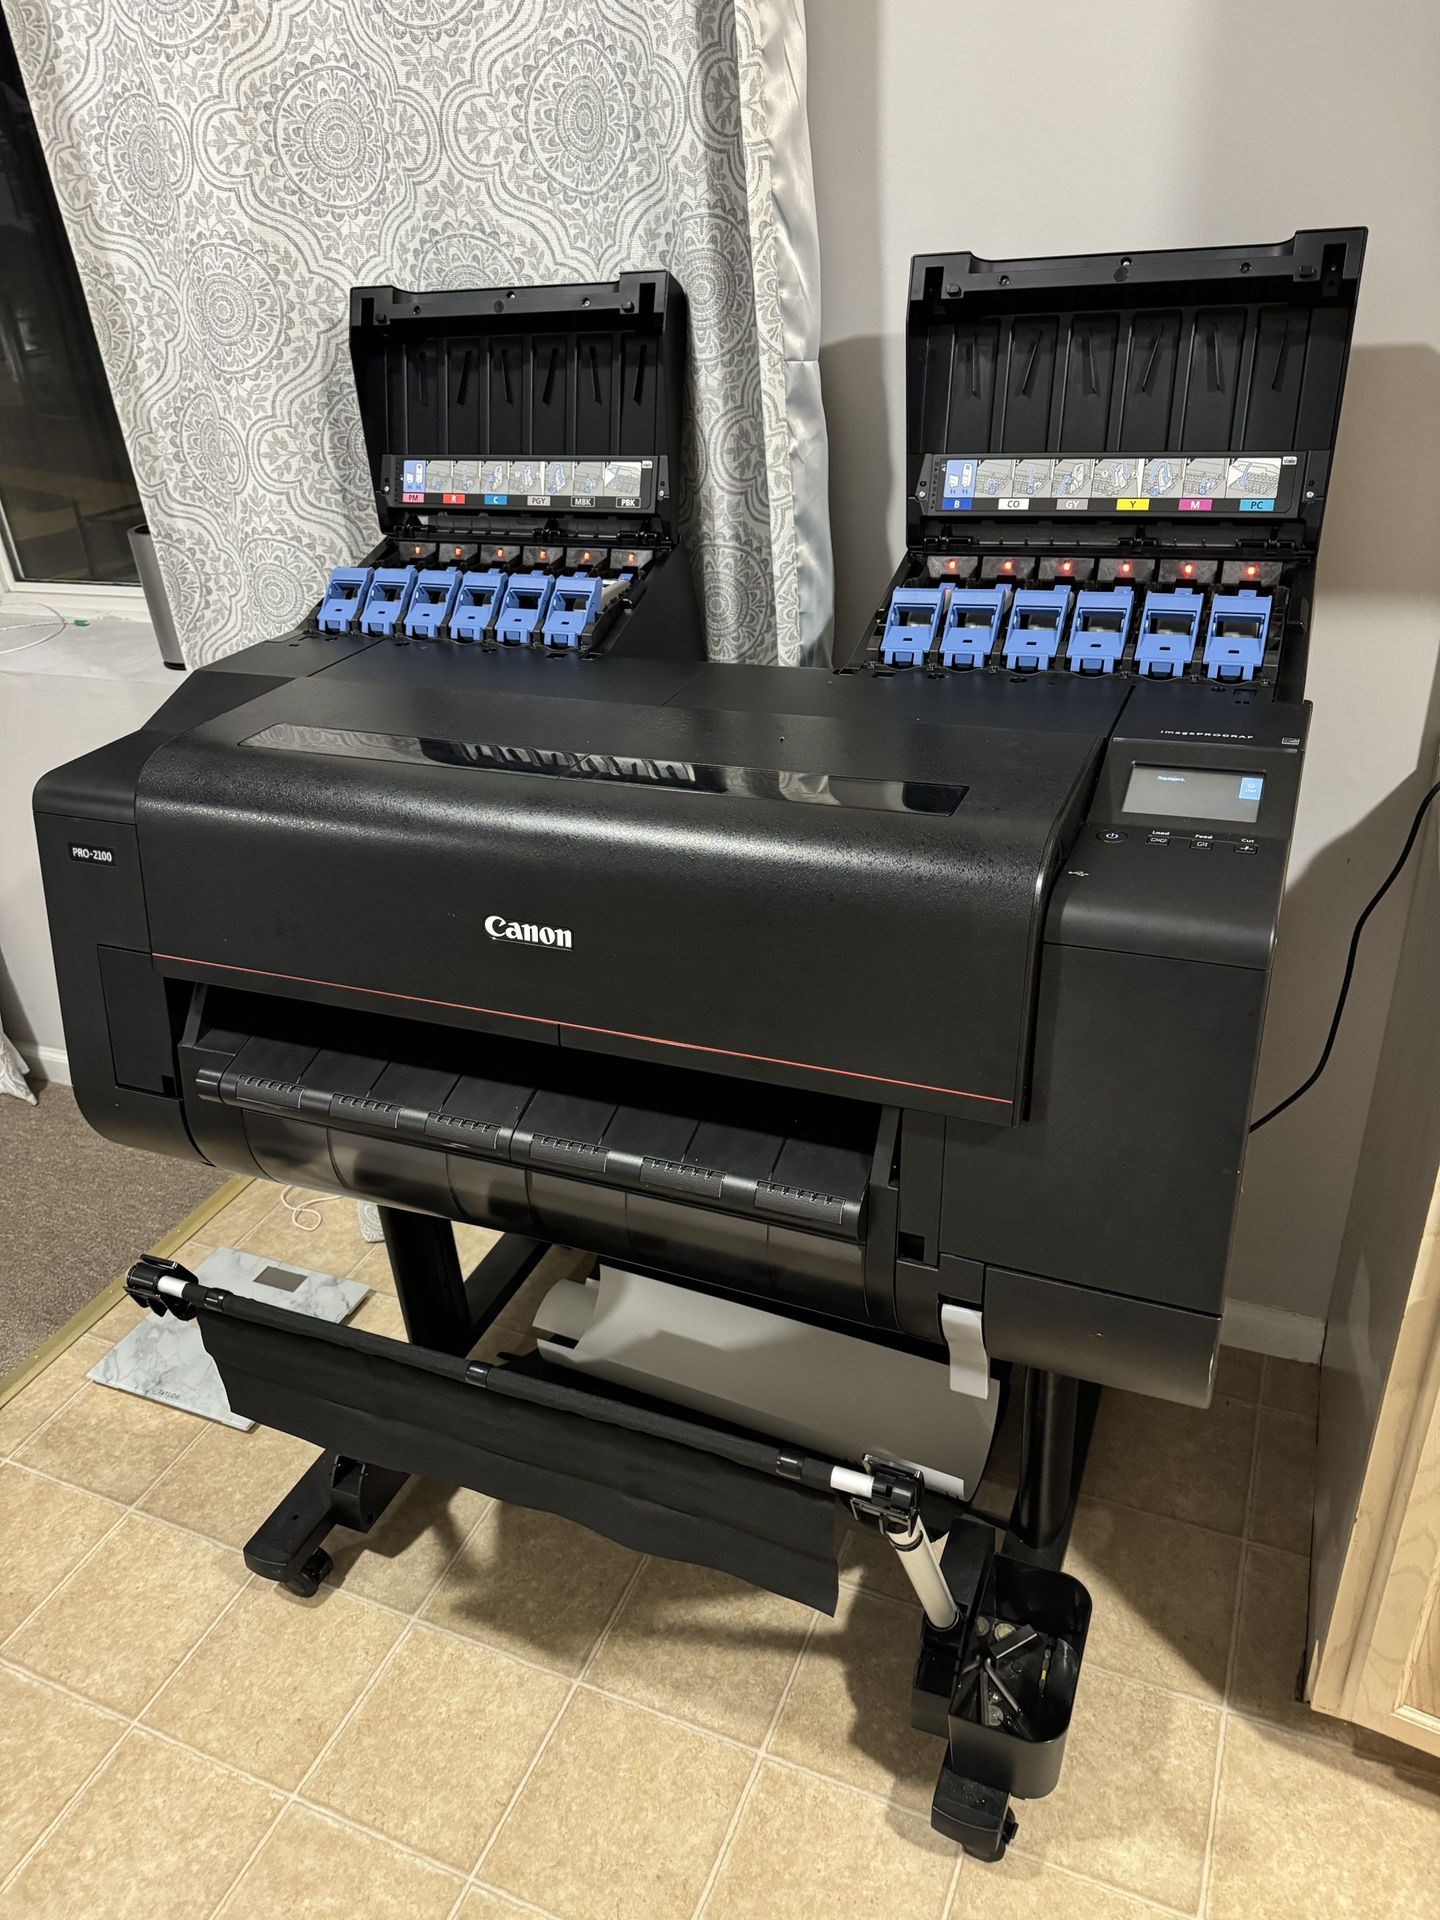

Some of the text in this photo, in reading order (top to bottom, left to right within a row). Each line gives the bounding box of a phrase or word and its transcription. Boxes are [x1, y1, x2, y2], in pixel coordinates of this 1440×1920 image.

[408, 494, 419, 502] PM
[493, 496, 498, 504] C
[532, 497, 546, 505] PGY
[575, 498, 591, 506] MBK
[621, 499, 636, 507] PBK
[954, 500, 960, 508] B
[1007, 500, 1020, 508] CO
[1065, 500, 1080, 508] GY
[1190, 501, 1200, 509] M
[1251, 501, 1263, 509] PC
[1160, 730, 1254, 739] imagePROGRAF
[72, 847, 112, 862] PRO-2100
[484, 915, 572, 948] Canon
